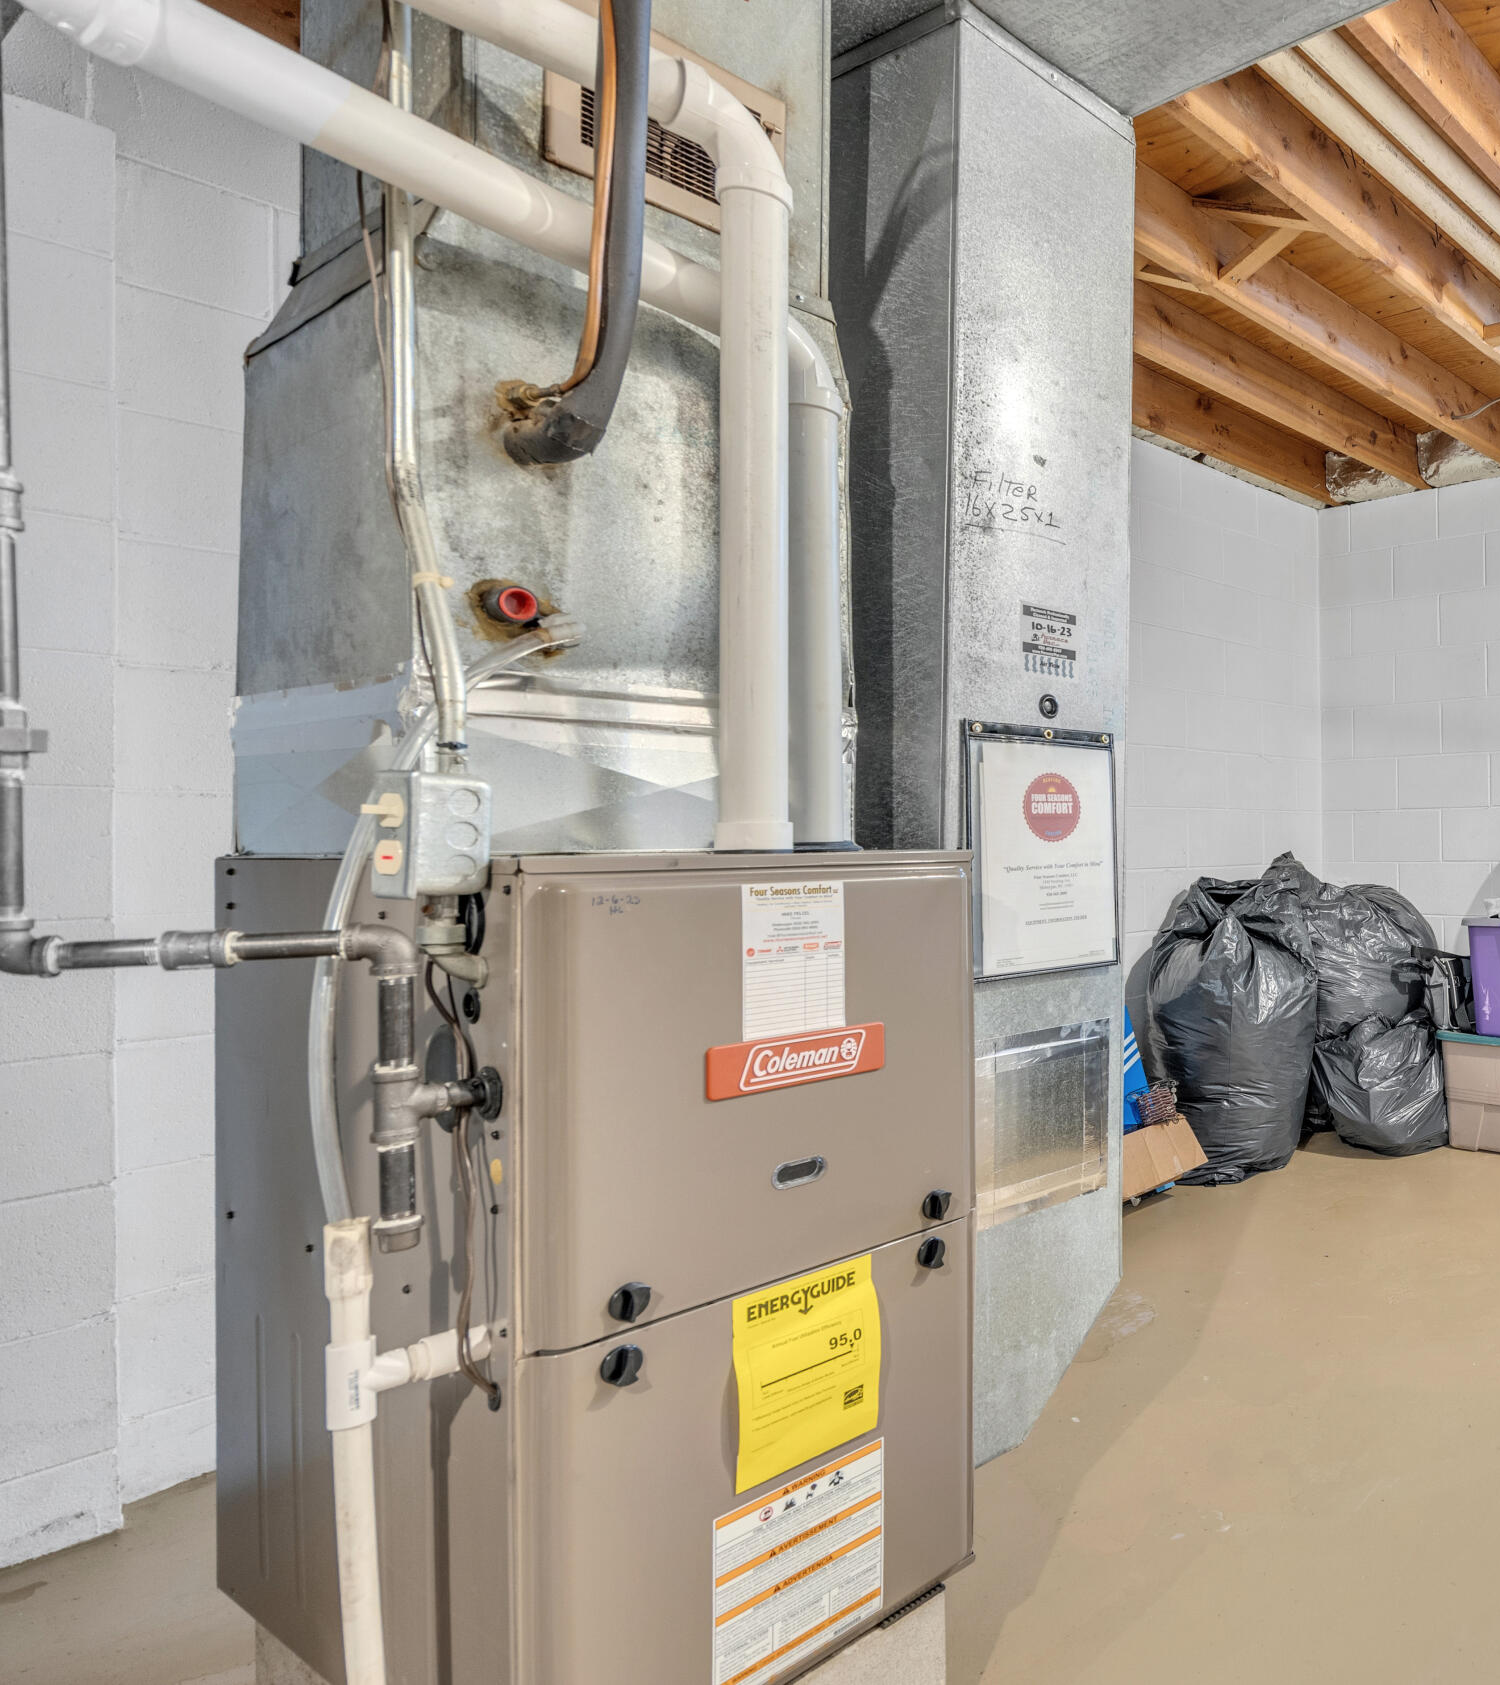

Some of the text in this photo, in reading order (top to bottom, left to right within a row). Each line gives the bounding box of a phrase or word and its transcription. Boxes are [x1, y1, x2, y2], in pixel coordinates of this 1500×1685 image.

[1031, 621, 1072, 637] 10-16-23
[1031, 793, 1073, 802] FOUR SEASONS
[1031, 802, 1074, 814] COMFORT
[749, 886, 768, 897] Four
[769, 886, 801, 897] Seasons
[802, 883, 832, 896] Comfort
[752, 1042, 839, 1078] Coleman
[746, 1271, 856, 1323] ENERGYGUIDE
[829, 1328, 862, 1350] 95.0
[790, 1469, 826, 1491] WARNING
[778, 1515, 839, 1553] AVERTISSEMENT
[781, 1553, 834, 1588] ADVERTENCIA
